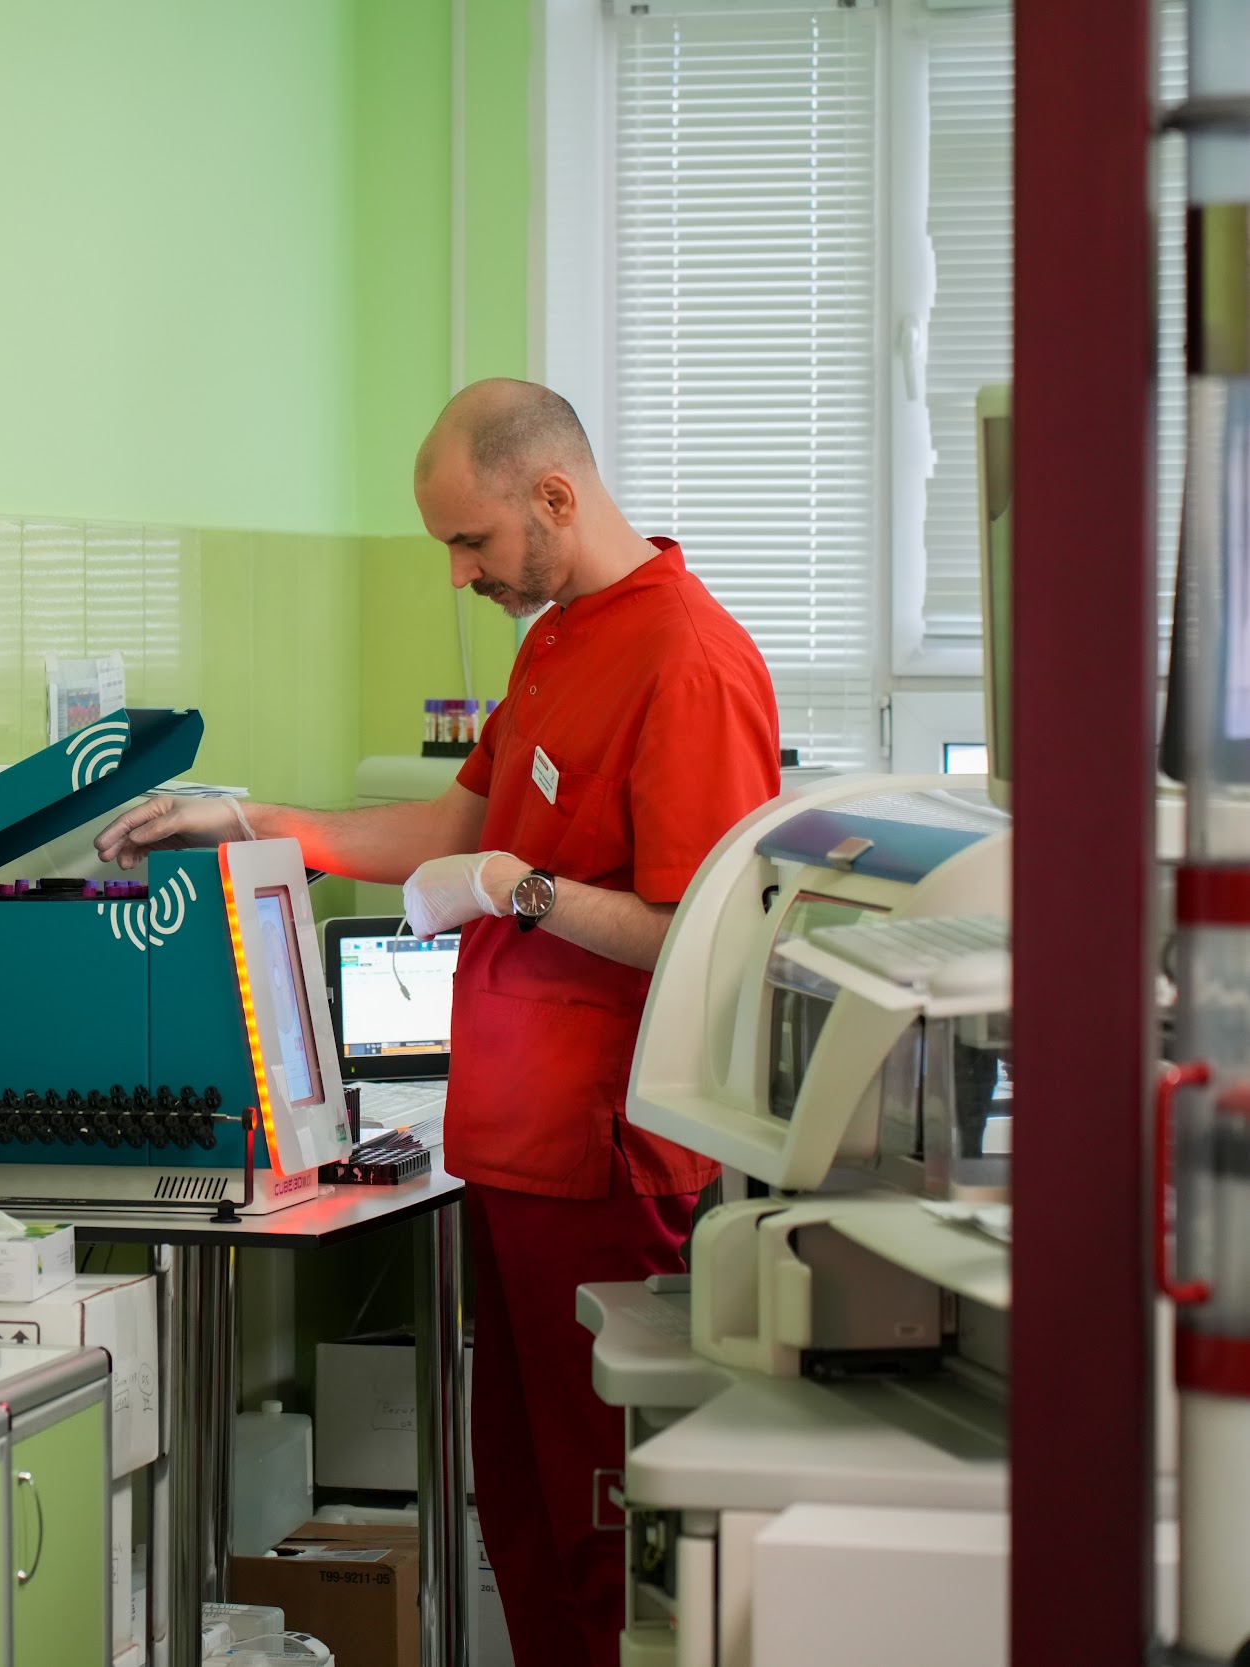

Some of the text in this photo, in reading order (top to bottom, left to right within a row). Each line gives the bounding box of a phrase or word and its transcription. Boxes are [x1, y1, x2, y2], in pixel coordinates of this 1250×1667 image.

[274, 1179, 293, 1196] CUBE
[319, 1570, 390, 1585] T99-9211-05
[480, 1584, 496, 1593] 20L
